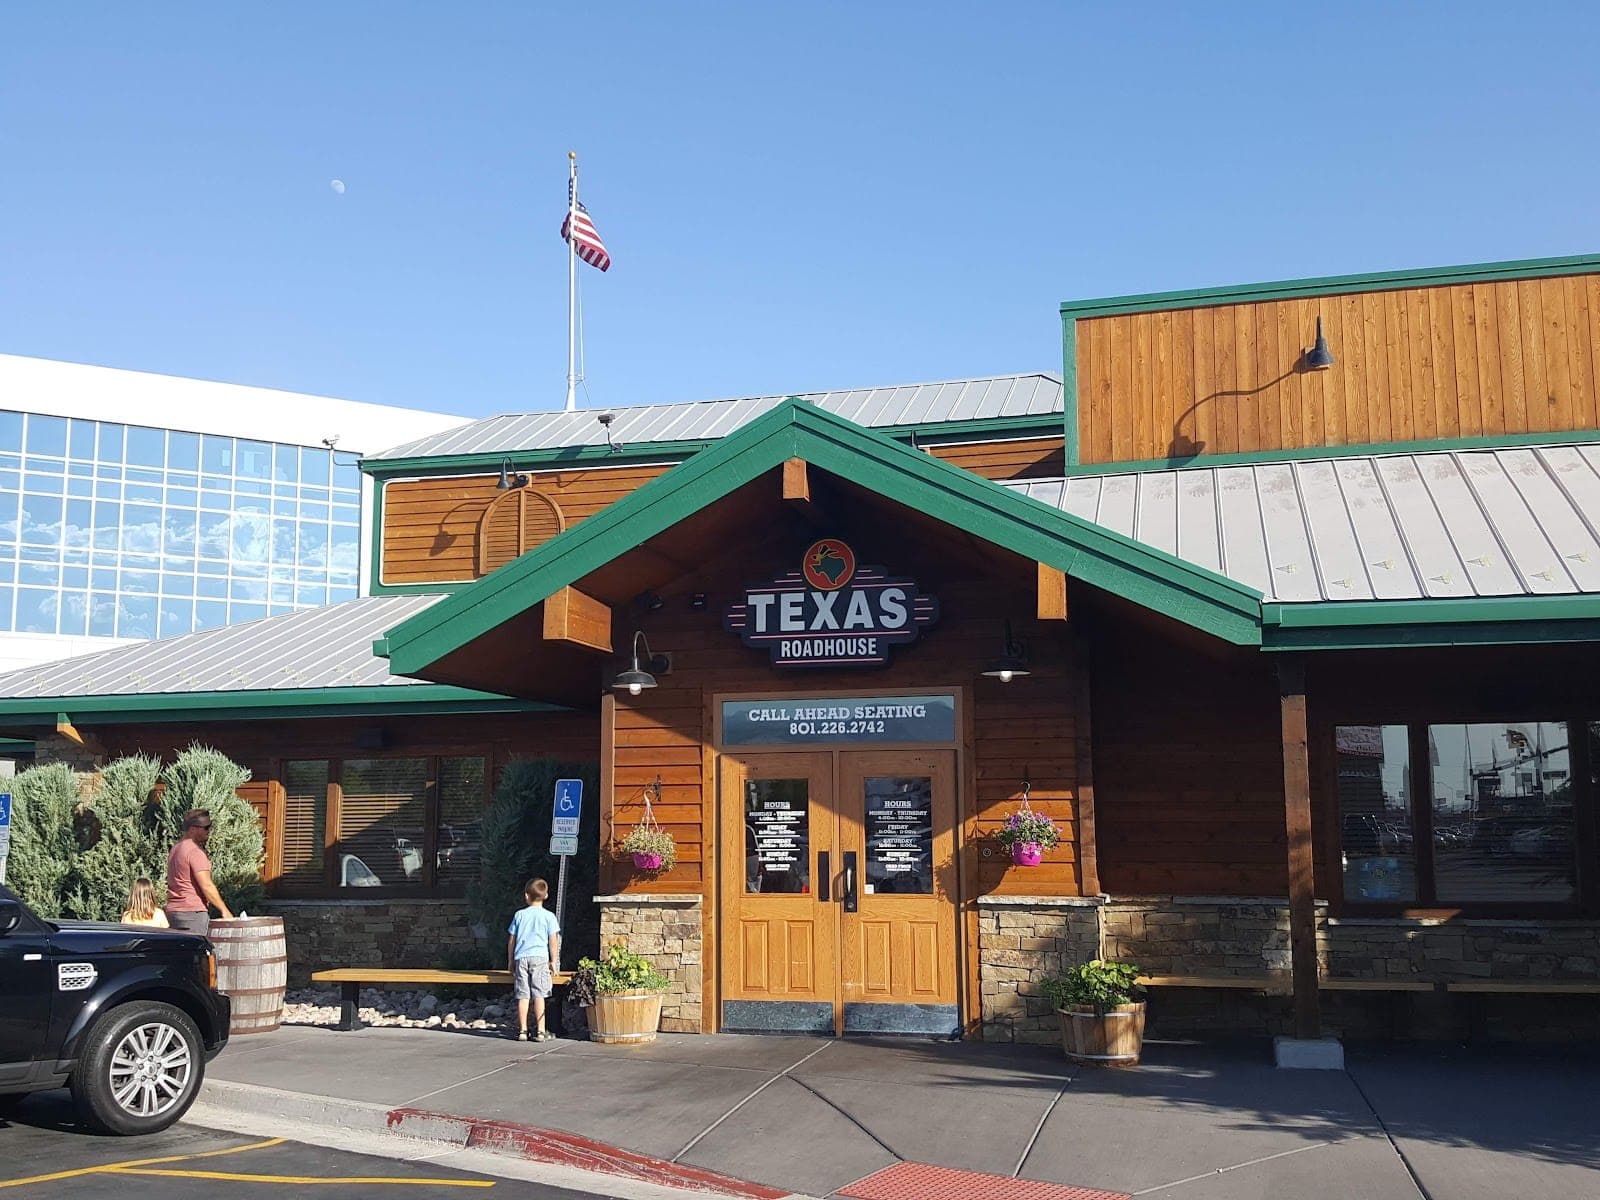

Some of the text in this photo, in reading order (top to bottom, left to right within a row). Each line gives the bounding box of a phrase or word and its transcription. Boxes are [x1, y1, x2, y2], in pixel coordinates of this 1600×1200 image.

[748, 588, 907, 632] TEXAS
[781, 638, 877, 658] ROADHOUSE
[749, 705, 926, 721] CALL AHEAD SEATING
[789, 721, 885, 735] 801.226.2742
